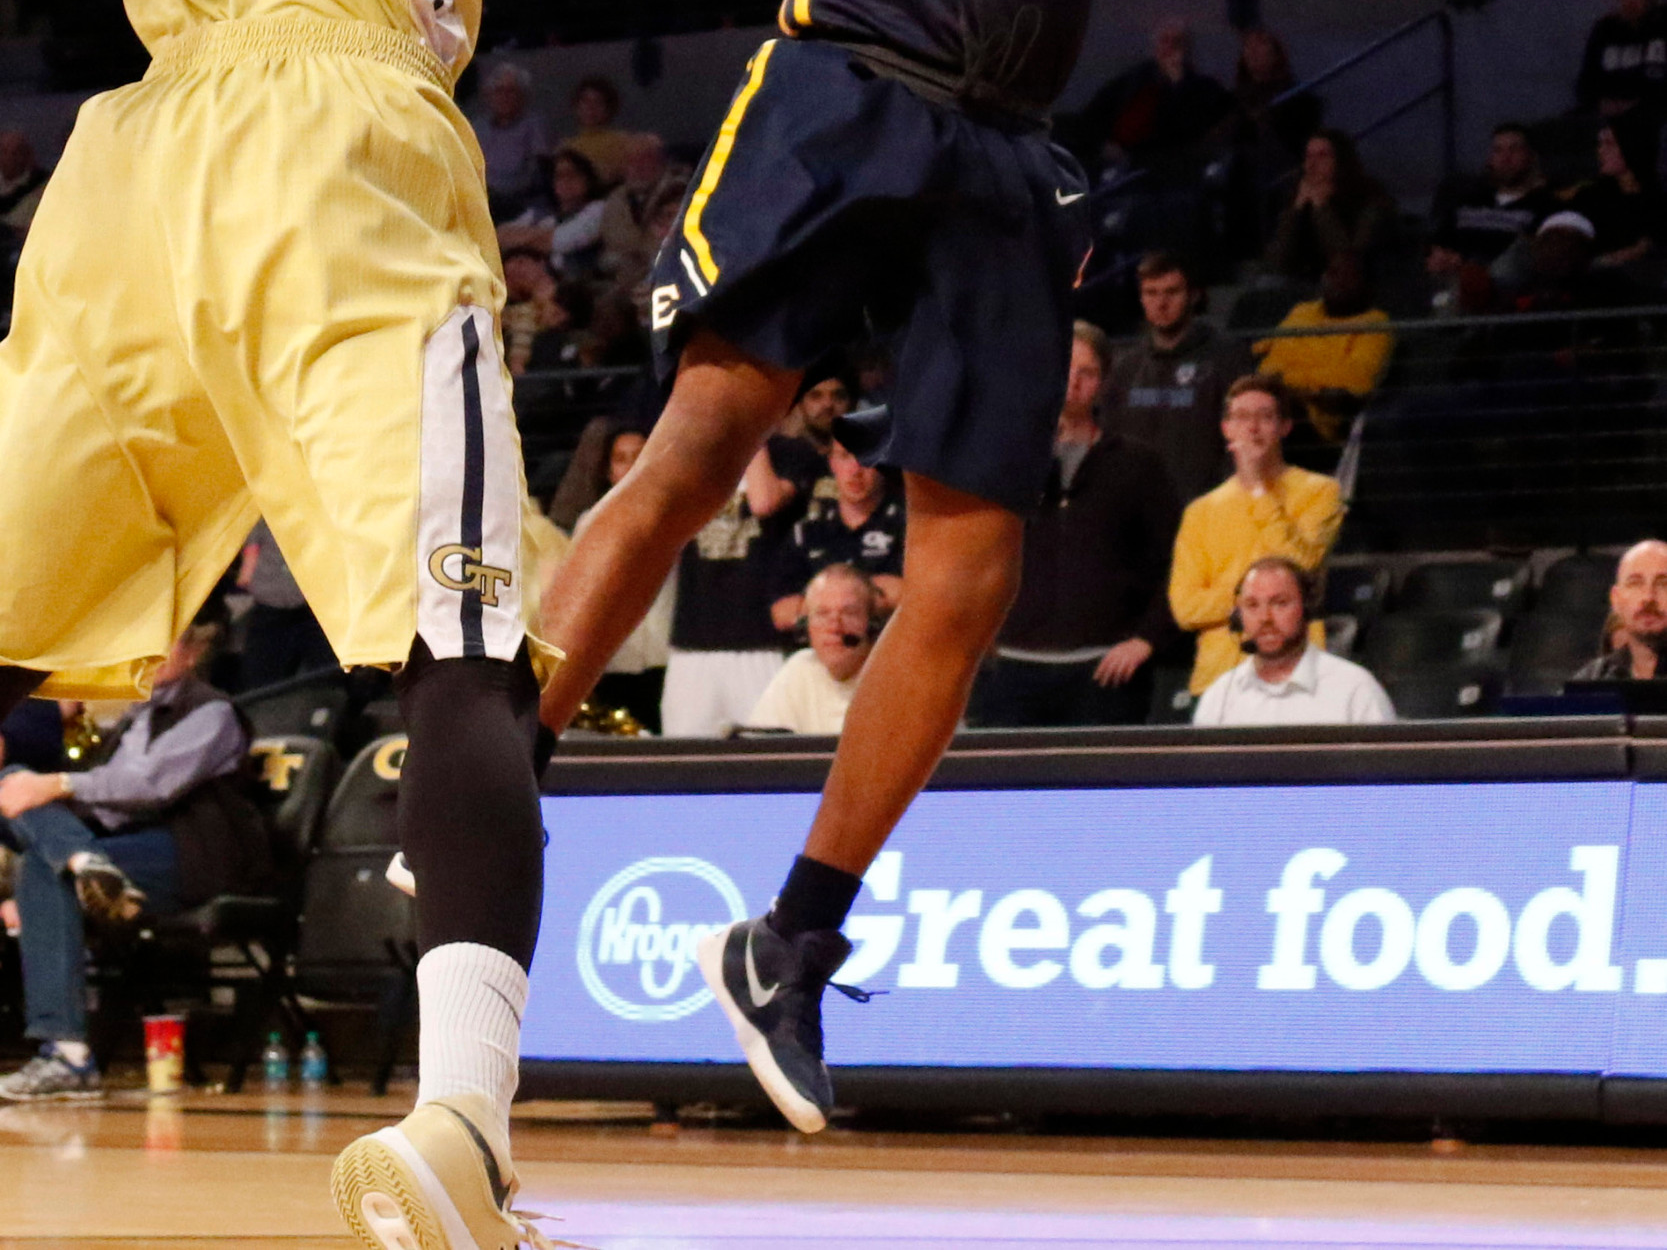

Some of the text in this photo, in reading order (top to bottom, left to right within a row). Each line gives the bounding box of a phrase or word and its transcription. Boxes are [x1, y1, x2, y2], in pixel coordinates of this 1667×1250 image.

[428, 543, 512, 607] GT
[598, 886, 731, 999] Kroge
[829, 845, 1667, 994] Great food.
